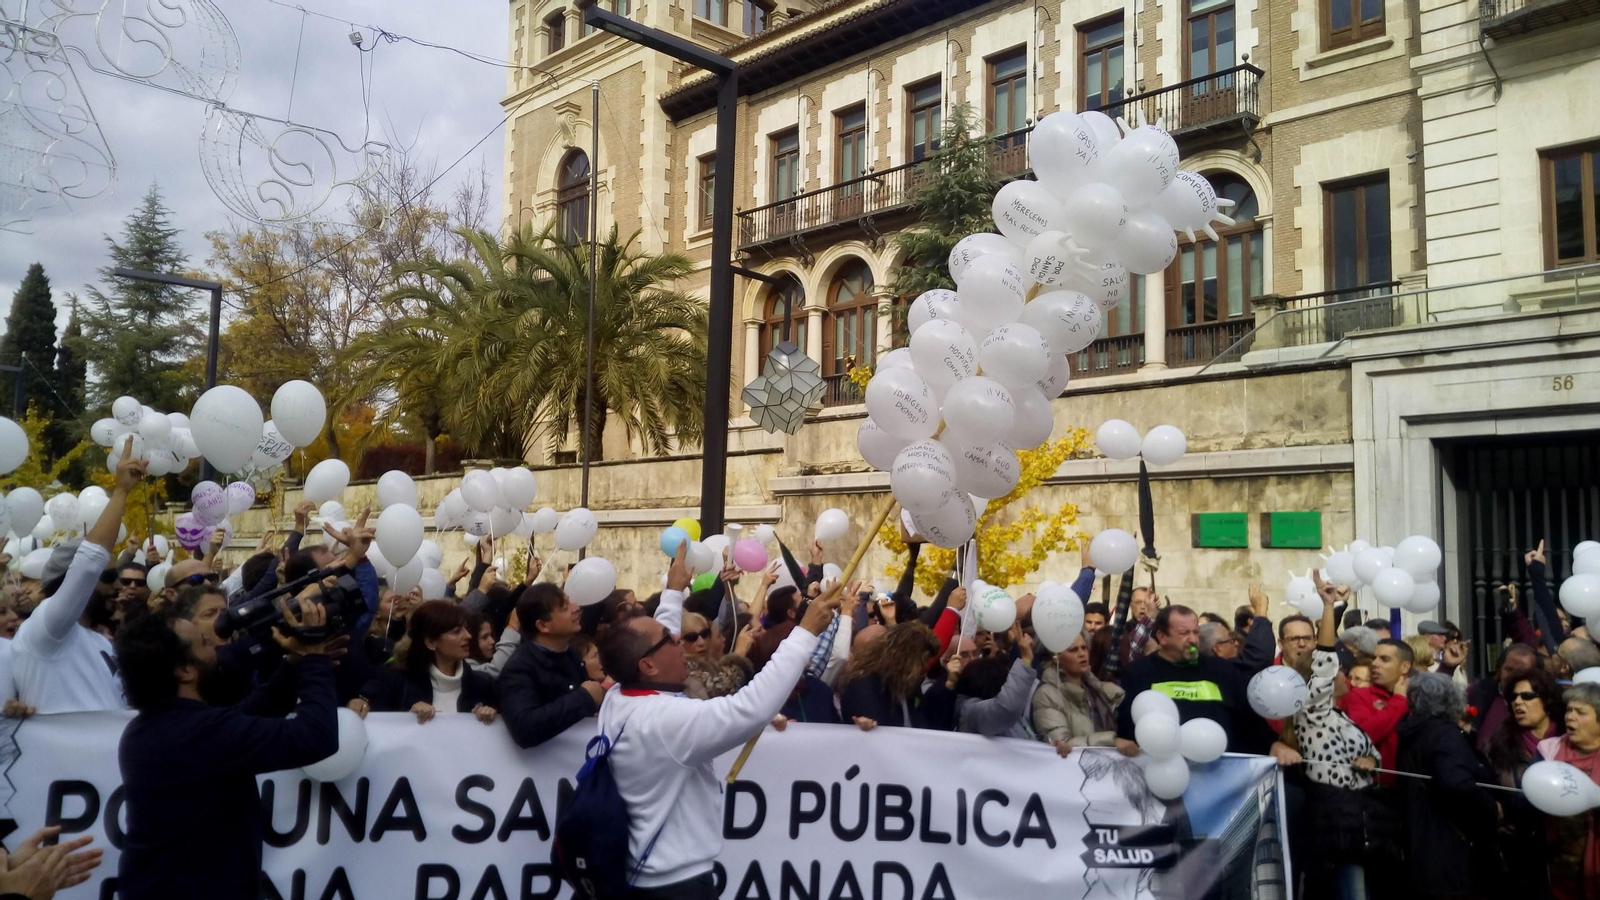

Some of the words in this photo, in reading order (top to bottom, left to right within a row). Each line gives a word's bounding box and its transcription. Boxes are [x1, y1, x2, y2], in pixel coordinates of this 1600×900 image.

[1553, 375, 1573, 391] 56
[261, 776, 427, 848] UNA
[789, 764, 1057, 849] PÚBLICA
[1095, 828, 1119, 845] TU
[1093, 847, 1154, 864] SALUD
